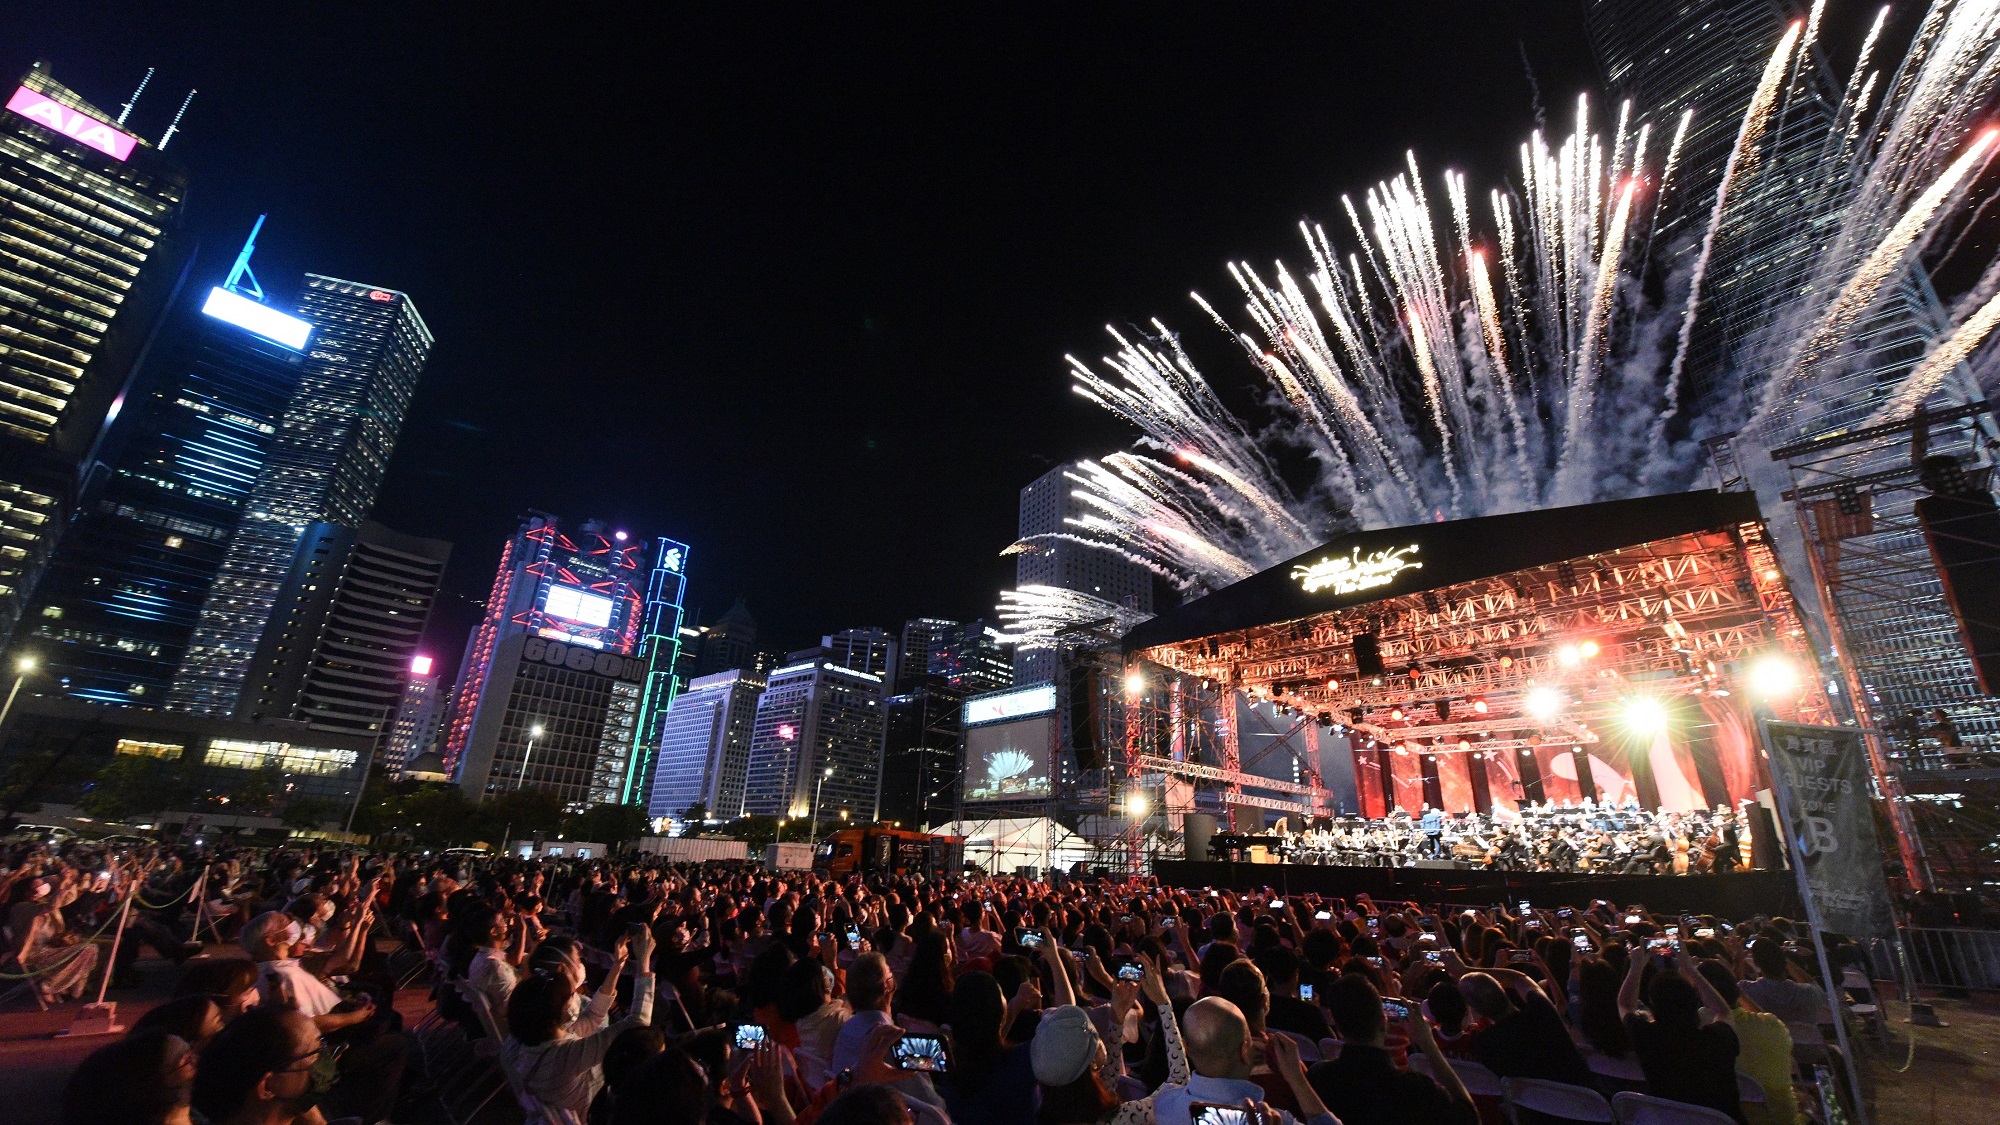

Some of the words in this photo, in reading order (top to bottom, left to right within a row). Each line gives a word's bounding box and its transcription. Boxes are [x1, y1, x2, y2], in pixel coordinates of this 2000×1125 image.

[21, 101, 116, 154] AIA
[1798, 757, 1825, 773] VIP
[1784, 772, 1853, 794] GUESTS
[1801, 799, 1837, 814] ZONE
[1808, 816, 1838, 853] B
